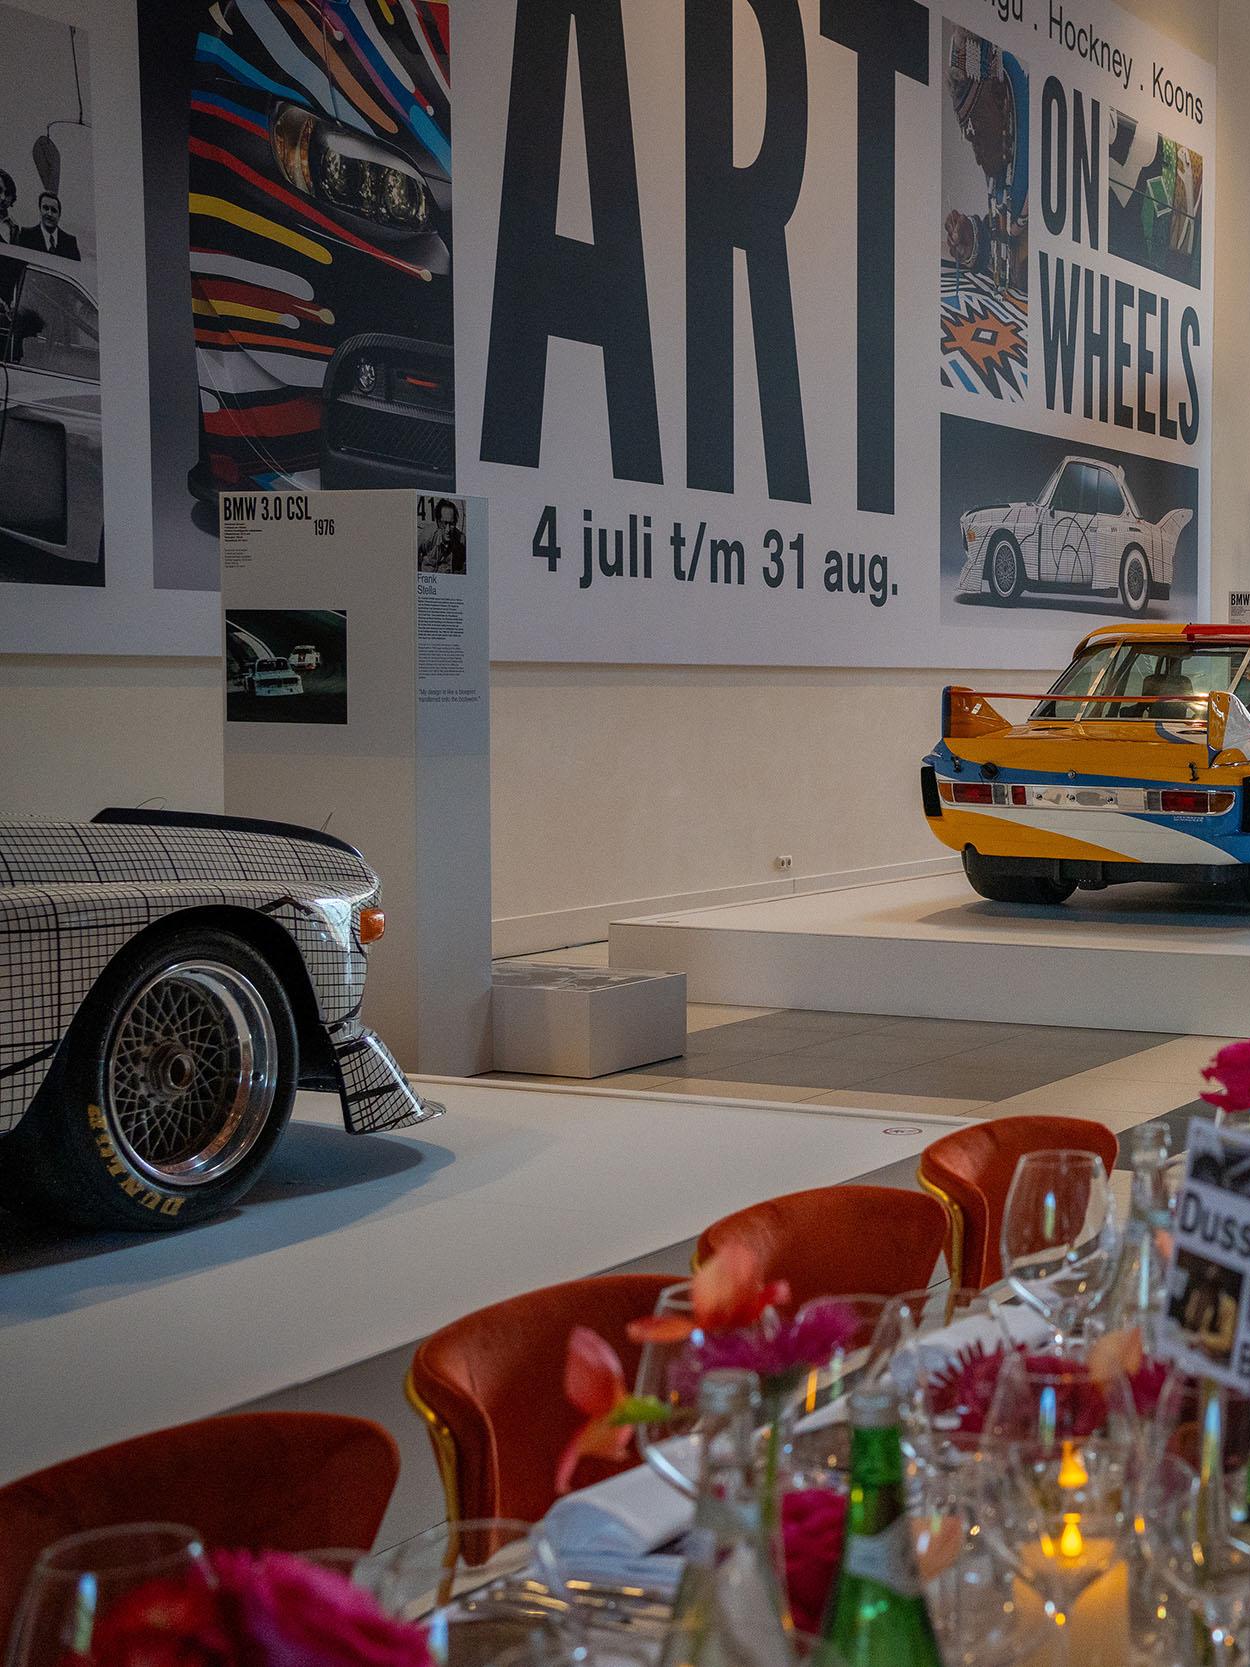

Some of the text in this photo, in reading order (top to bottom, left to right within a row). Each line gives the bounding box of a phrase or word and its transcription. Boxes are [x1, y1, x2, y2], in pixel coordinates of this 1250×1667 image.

[1049, 0, 1133, 89] Hockney
[1152, 62, 1203, 124] Koons
[1041, 75, 1100, 250] ON
[480, 0, 929, 515] ART
[1039, 250, 1201, 445] WHEELS
[223, 496, 312, 520] BMW 3.0 CSL
[313, 519, 335, 536] 1976
[417, 573, 437, 584] Frank
[532, 505, 898, 607] 4 juli t/m 31 aug.
[417, 584, 437, 595] Stella
[1231, 593, 1250, 605] BMW
